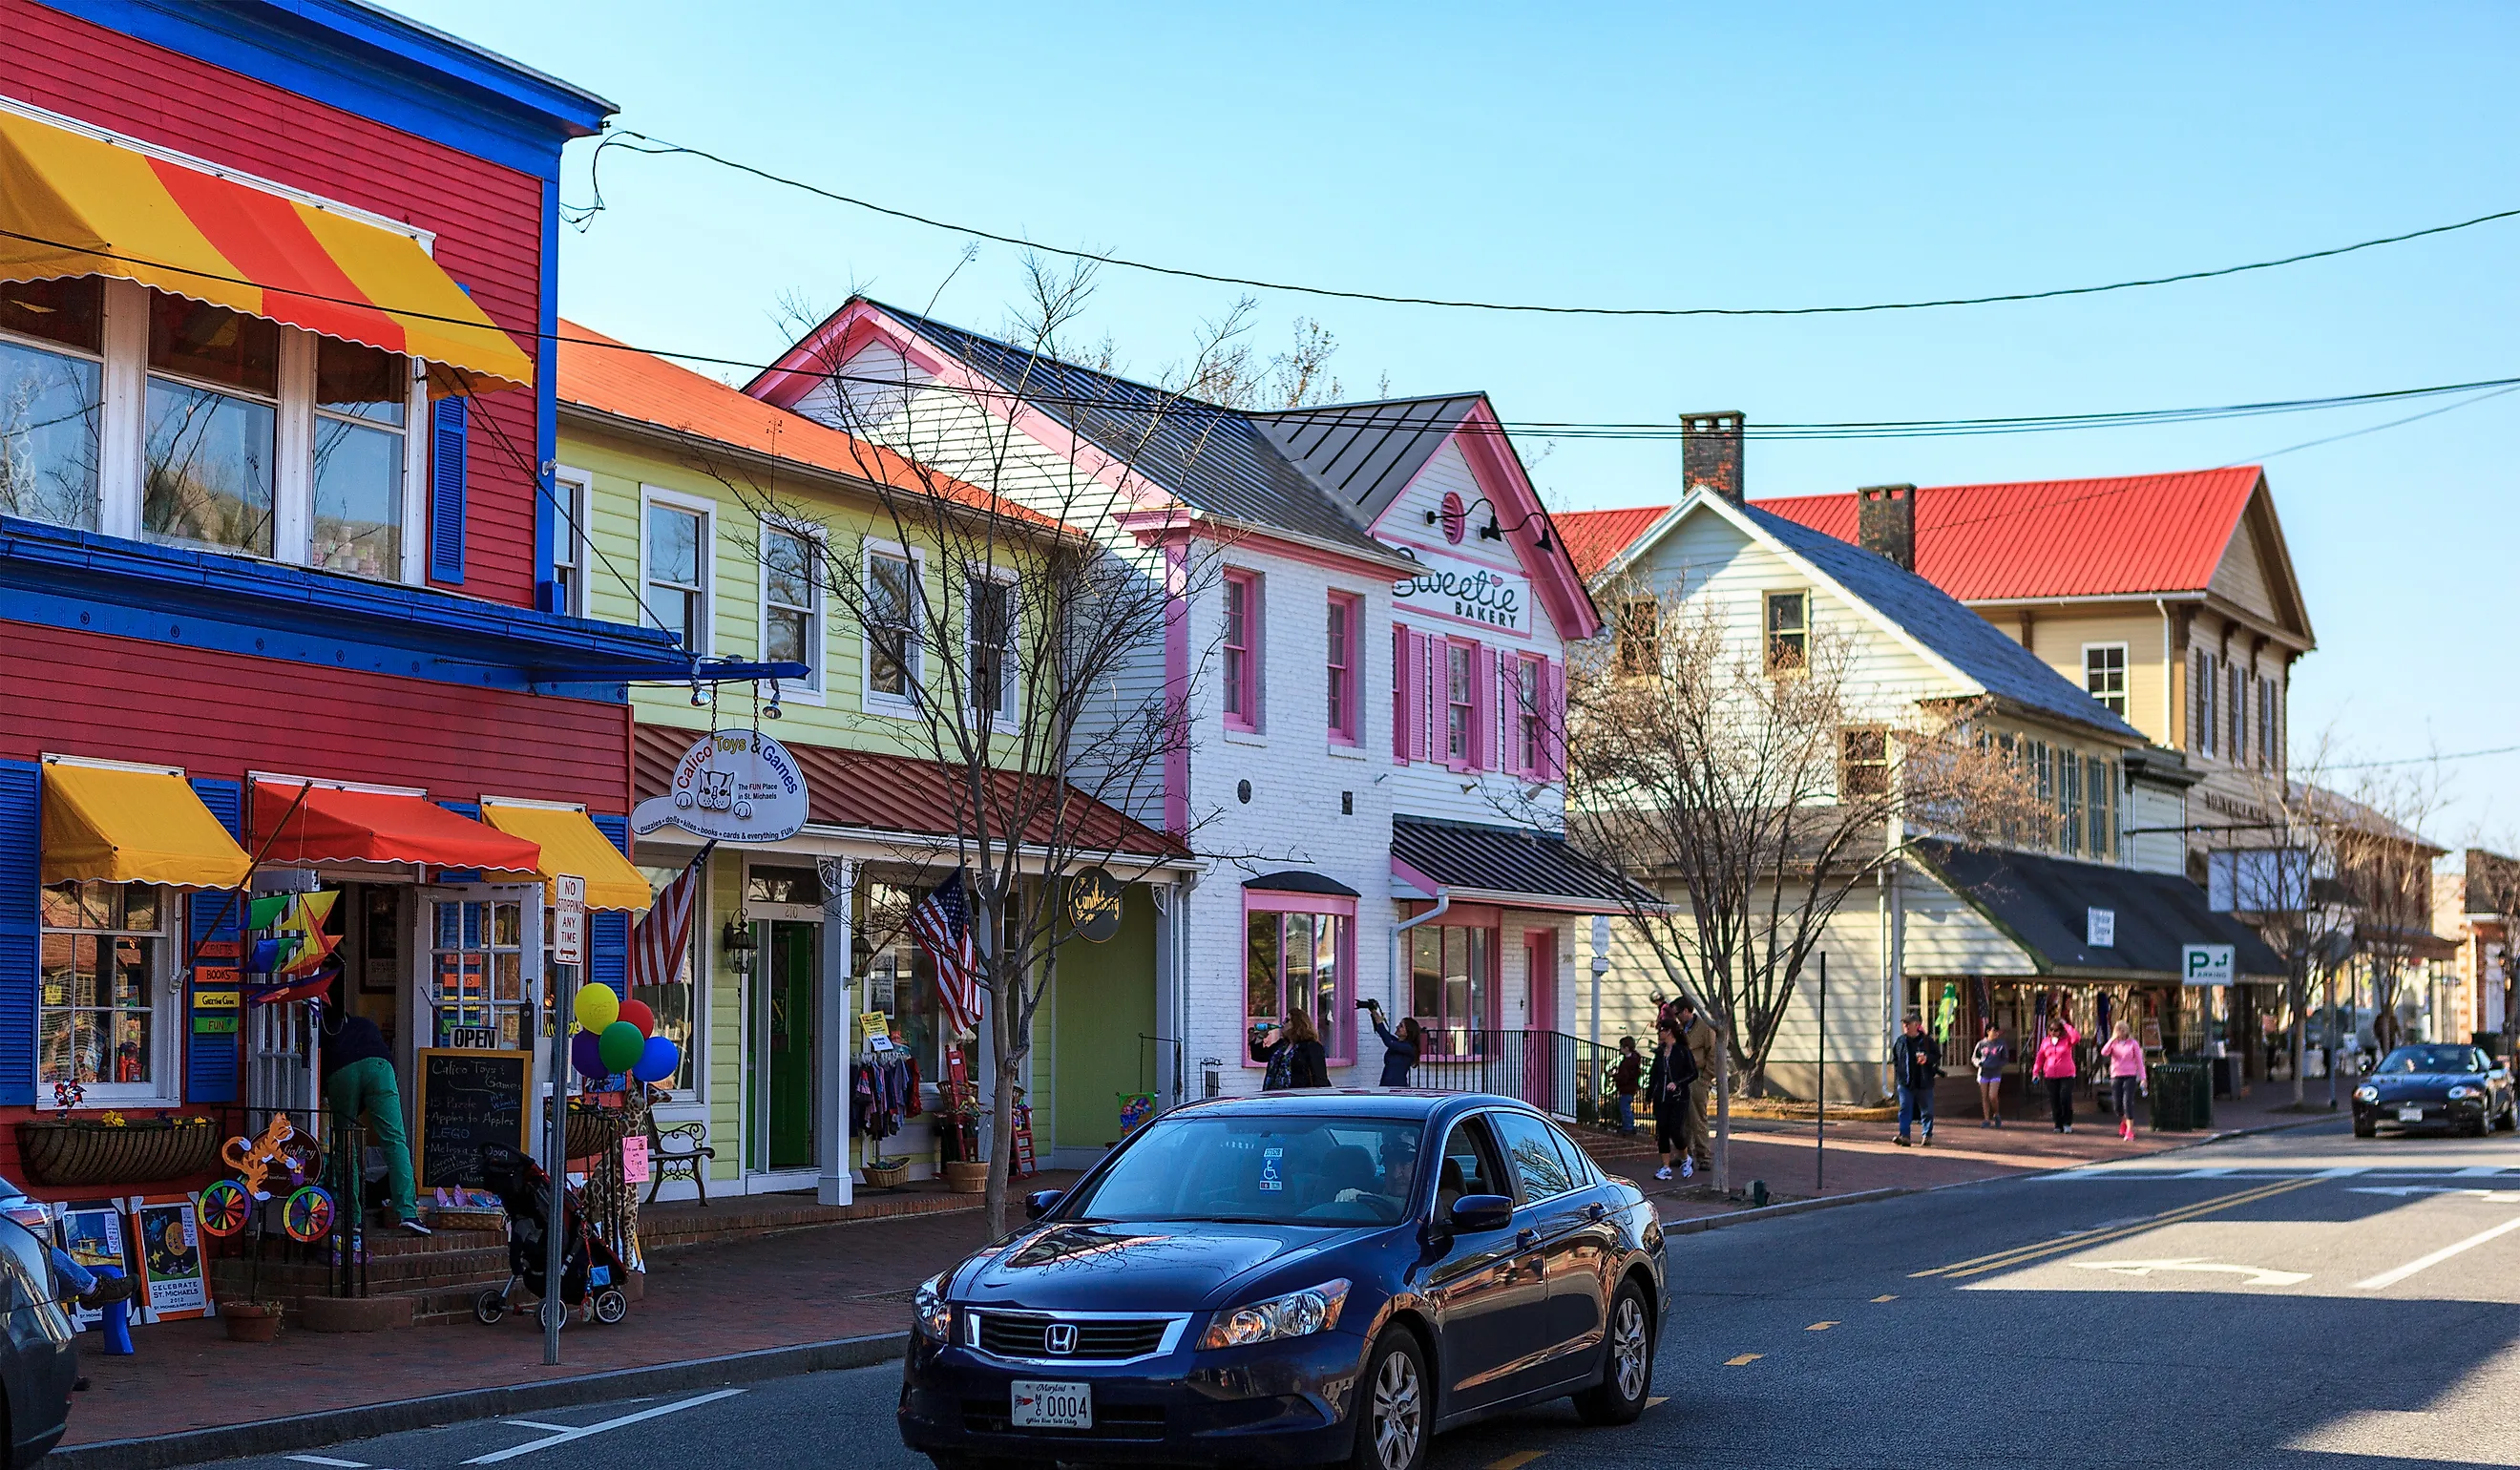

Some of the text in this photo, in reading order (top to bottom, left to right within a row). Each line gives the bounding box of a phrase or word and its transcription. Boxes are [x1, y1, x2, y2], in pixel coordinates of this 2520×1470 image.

[1455, 601, 1517, 629] BAKERY
[677, 736, 797, 794] Calico Toys & Games
[640, 820, 662, 833] puzzles
[665, 816, 680, 825] dolls
[682, 820, 697, 831] kites
[701, 827, 718, 837] books
[724, 830, 741, 840] cards
[746, 830, 779, 840] everything
[781, 826, 794, 837] FUN
[564, 880, 576, 896] NO
[557, 898, 583, 914] STOPPING
[561, 916, 577, 929] ANY
[561, 931, 577, 944] TIME
[206, 970, 231, 980] BOOKS
[208, 1020, 224, 1031] FUN
[454, 1028, 495, 1048] OPEN
[432, 1060, 468, 1076] Calico
[471, 1060, 496, 1079] Toys
[485, 1077, 522, 1091] Games
[430, 1111, 515, 1127] Apples to Apples
[431, 1127, 471, 1139] LEGO
[152, 1281, 198, 1292] CELEBRATE
[164, 1289, 199, 1298] MICHAELS
[1036, 1383, 1066, 1394] Maryland
[1047, 1396, 1087, 1418] 0004
